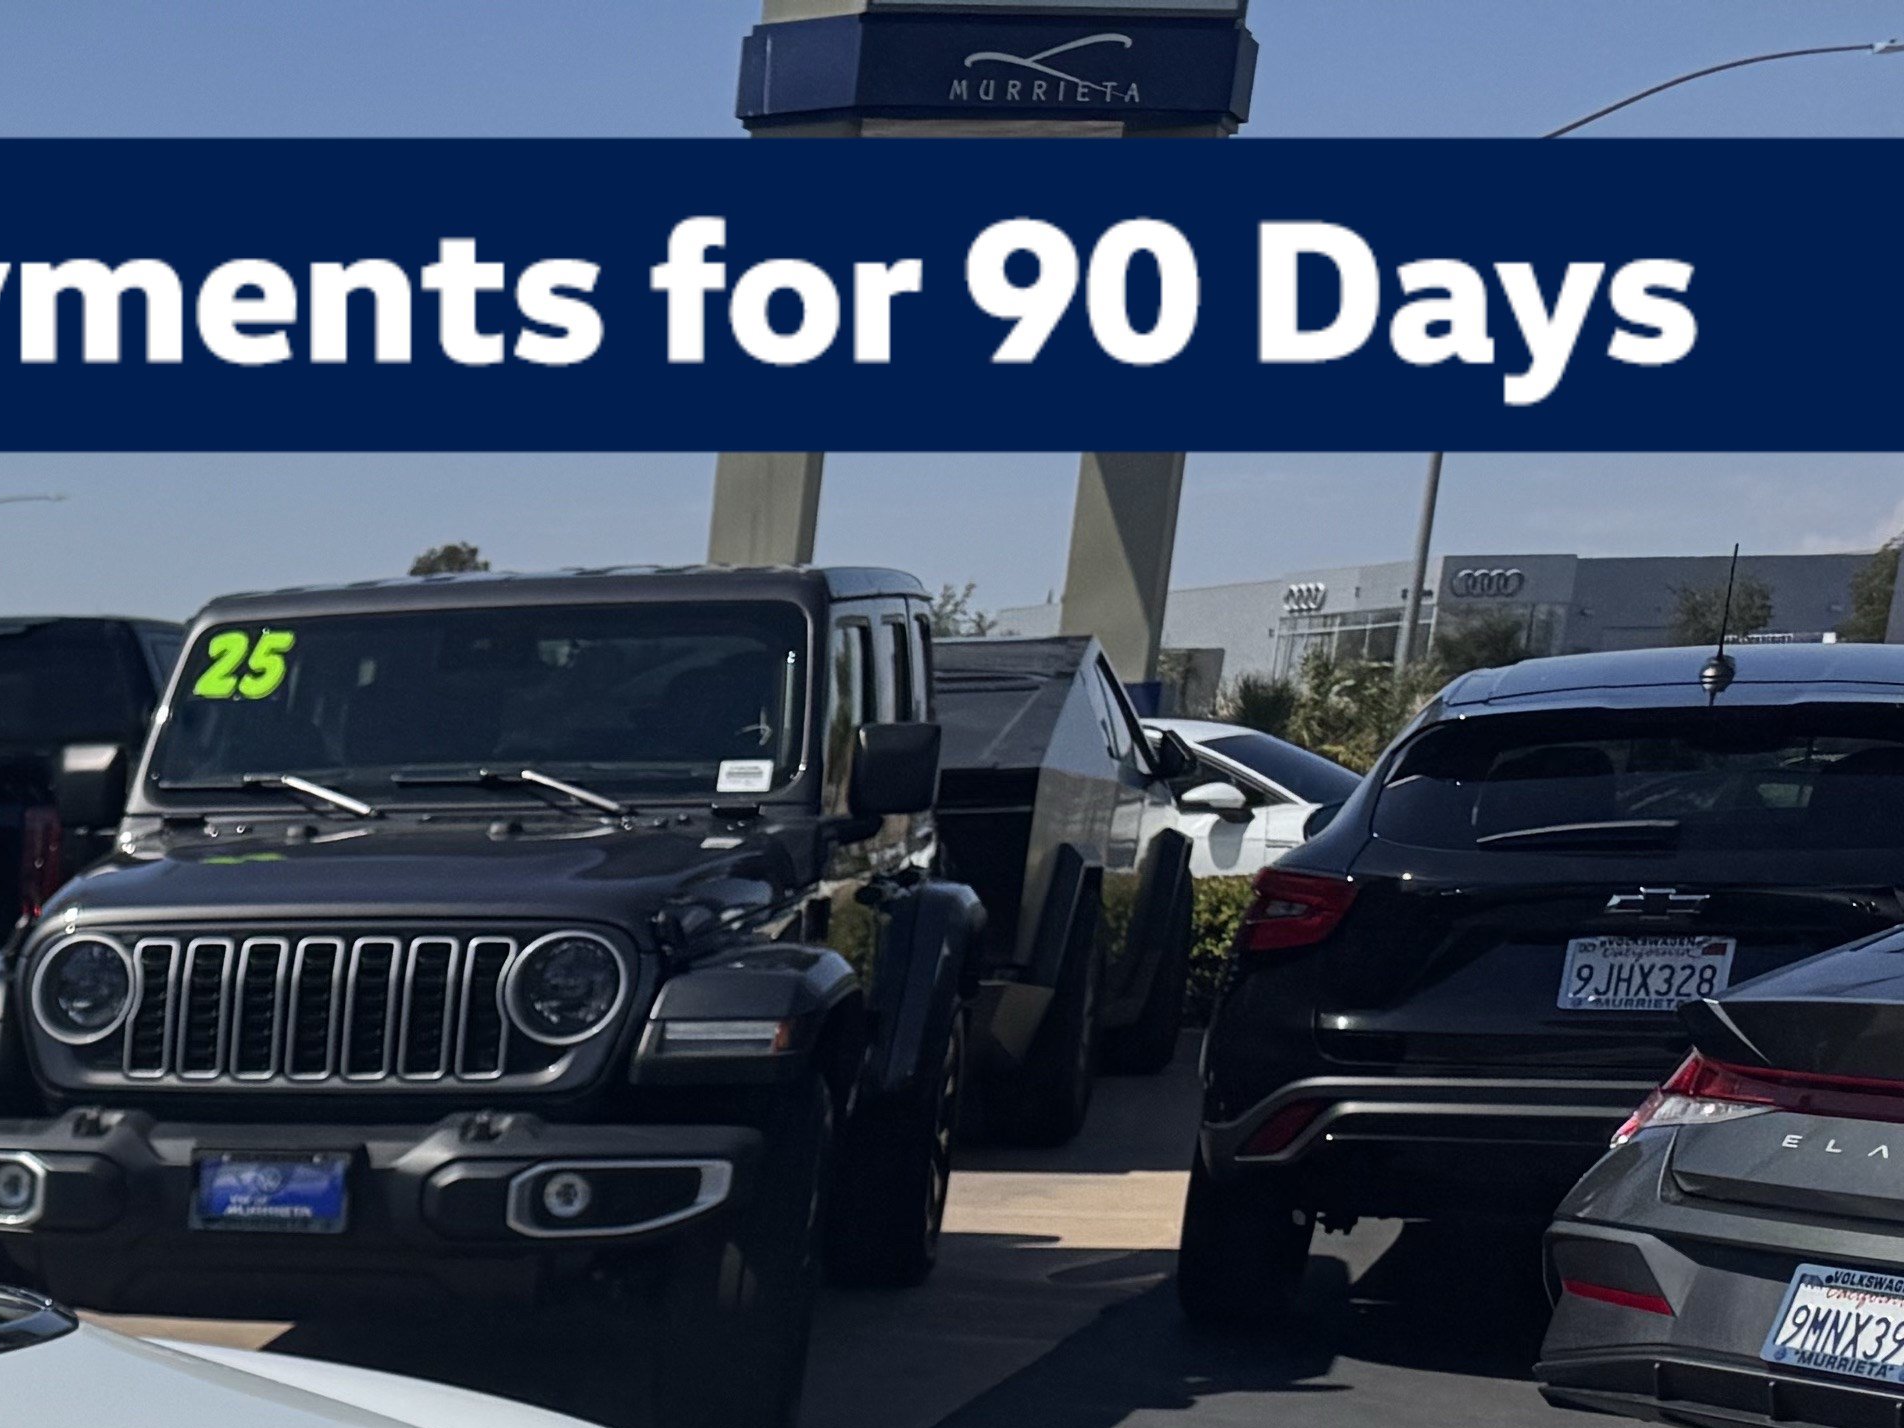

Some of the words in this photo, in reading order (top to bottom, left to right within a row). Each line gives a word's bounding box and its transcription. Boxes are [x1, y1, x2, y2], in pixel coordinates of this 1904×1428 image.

[949, 79, 1140, 103] MURRIETA
[193, 629, 295, 700] 25
[1573, 963, 1718, 998] 9JHX328
[1594, 999, 1679, 1011] MURRIET
[1833, 1270, 1904, 1294] VOLKSWAG
